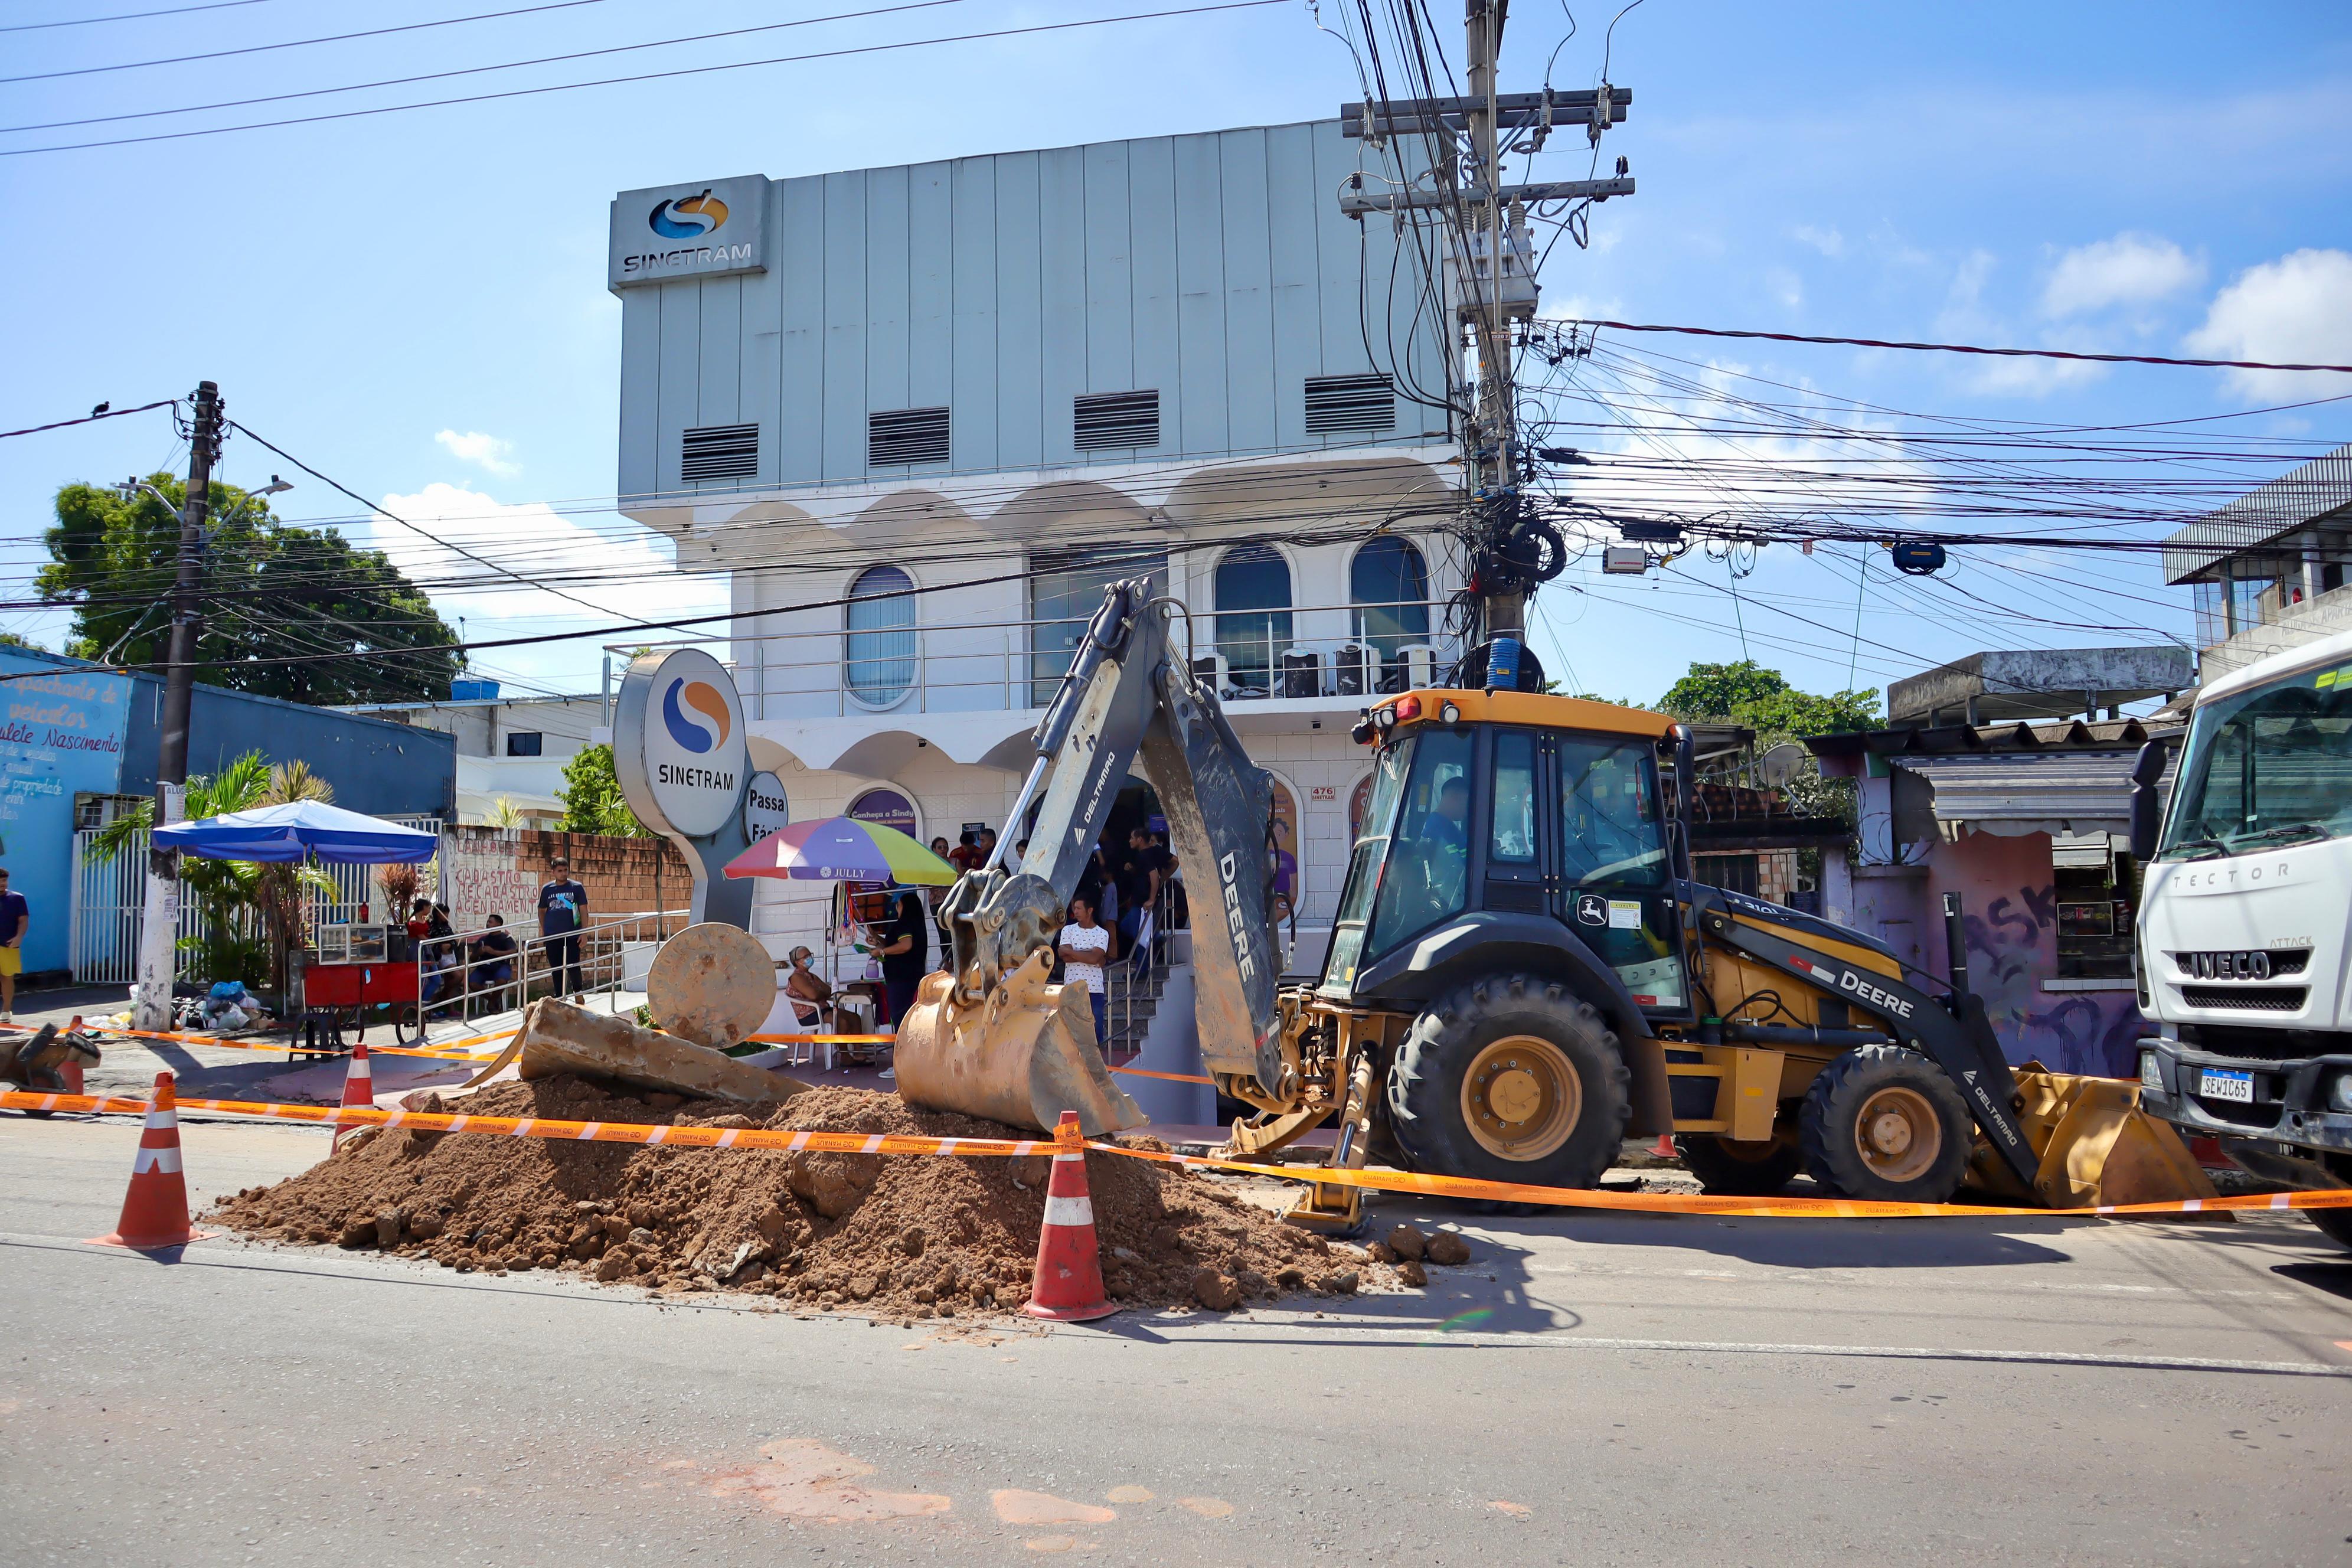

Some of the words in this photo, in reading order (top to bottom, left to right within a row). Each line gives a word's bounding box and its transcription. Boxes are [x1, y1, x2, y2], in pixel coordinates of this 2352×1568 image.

[623, 242, 752, 273] SINETRAM
[0, 722, 34, 744] ulete
[41, 727, 119, 753] Nascimento
[659, 764, 733, 791] SINETRAM
[749, 789, 785, 812] Passa
[851, 811, 883, 819] Conheça
[891, 809, 914, 818] Sindy
[456, 869, 521, 885] CADASTRO
[834, 868, 866, 878] JULLY
[2174, 863, 2289, 888] TECTOR
[458, 884, 538, 900] RECADASTRO
[456, 899, 537, 914] AGENDAMENT
[1220, 851, 1255, 984] DEERE
[2269, 936, 2313, 949] ATTACK
[2191, 951, 2271, 980] IVECO
[1840, 970, 1915, 1019] DEERE
[2205, 1077, 2248, 1098] SEW1C65
